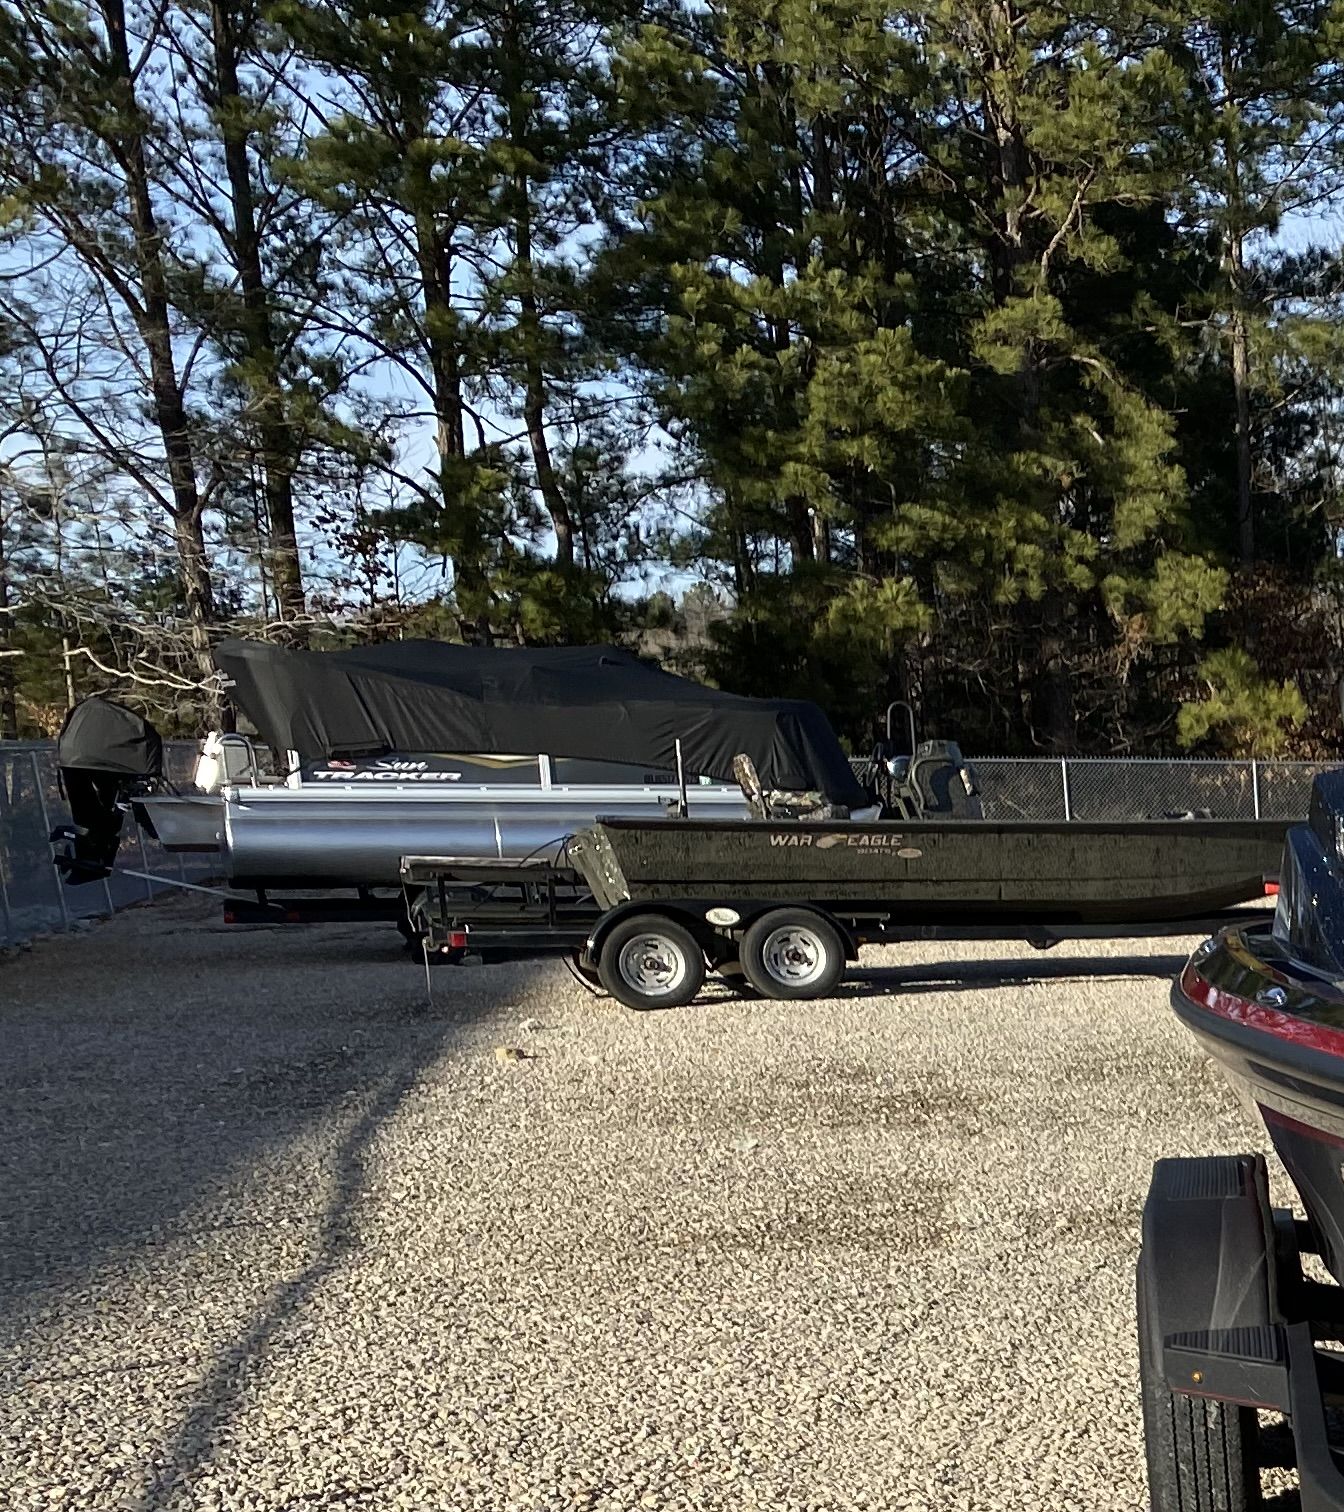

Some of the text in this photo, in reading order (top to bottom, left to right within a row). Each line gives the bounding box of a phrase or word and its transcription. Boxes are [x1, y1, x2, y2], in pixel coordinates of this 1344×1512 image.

[367, 757, 428, 770] Sun
[313, 771, 462, 781] TRACKER
[770, 834, 903, 847] WAR EAGLE
